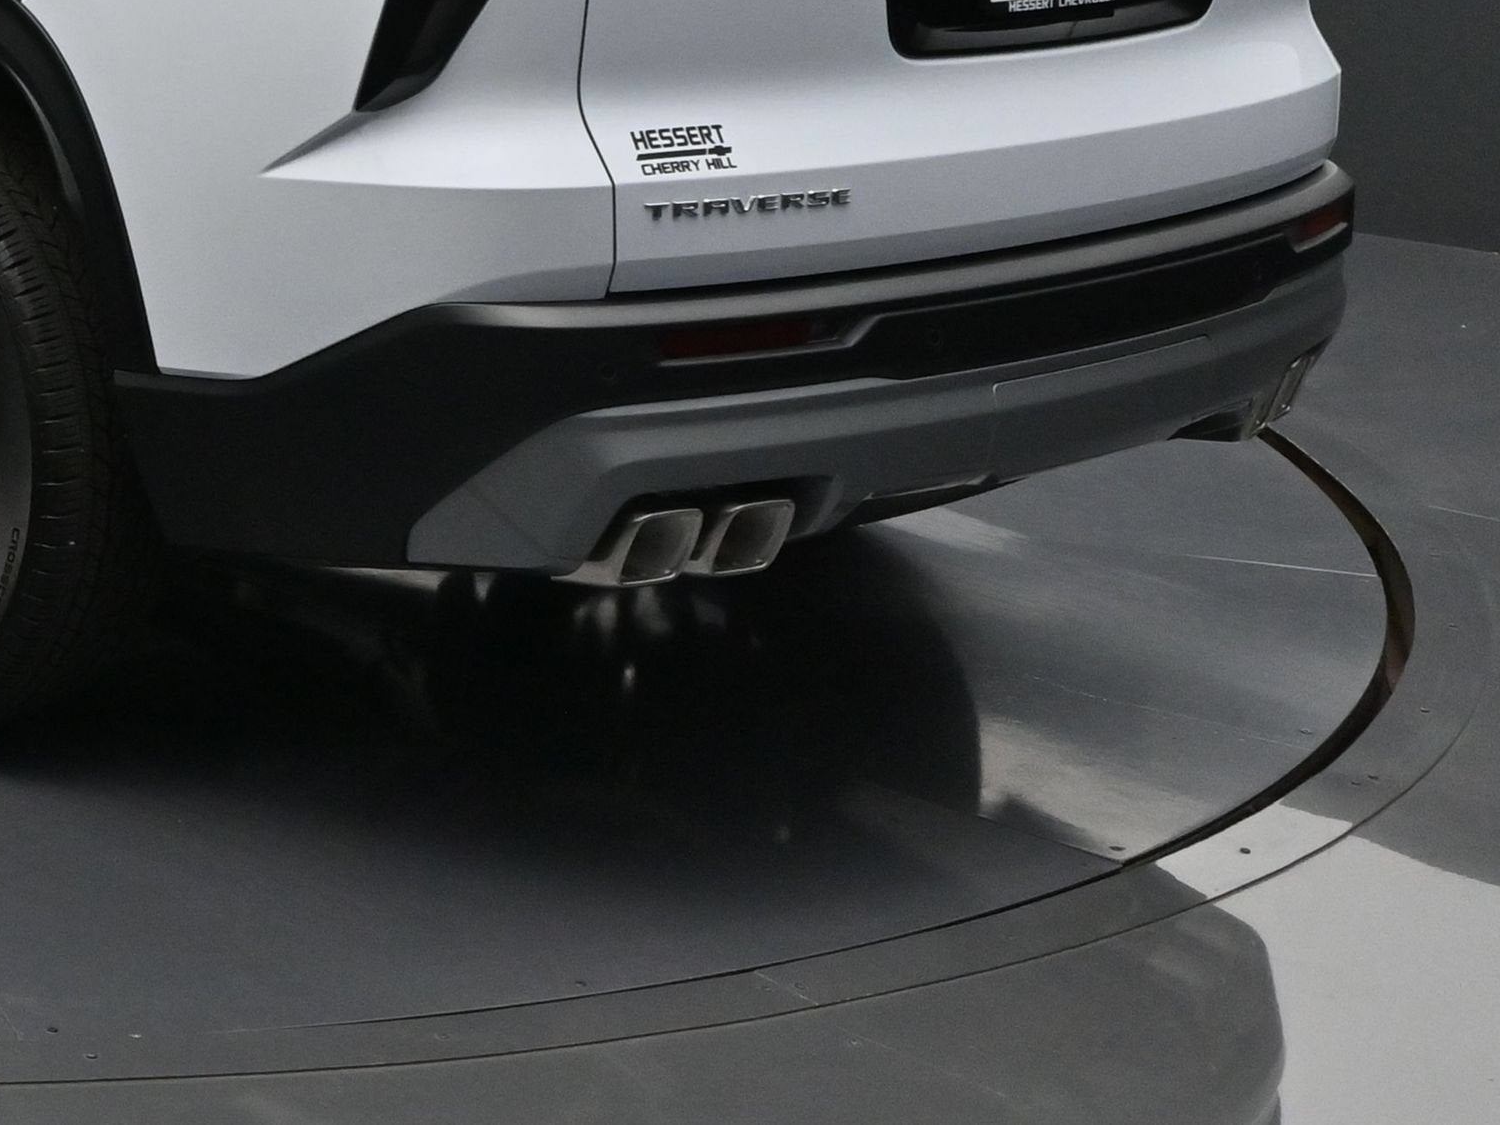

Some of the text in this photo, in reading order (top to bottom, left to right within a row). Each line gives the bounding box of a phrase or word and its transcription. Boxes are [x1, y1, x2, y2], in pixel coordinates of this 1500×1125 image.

[630, 123, 725, 151] HESSERT
[640, 156, 738, 176] CHERRY HILL
[643, 187, 852, 221] TRAVERSE
